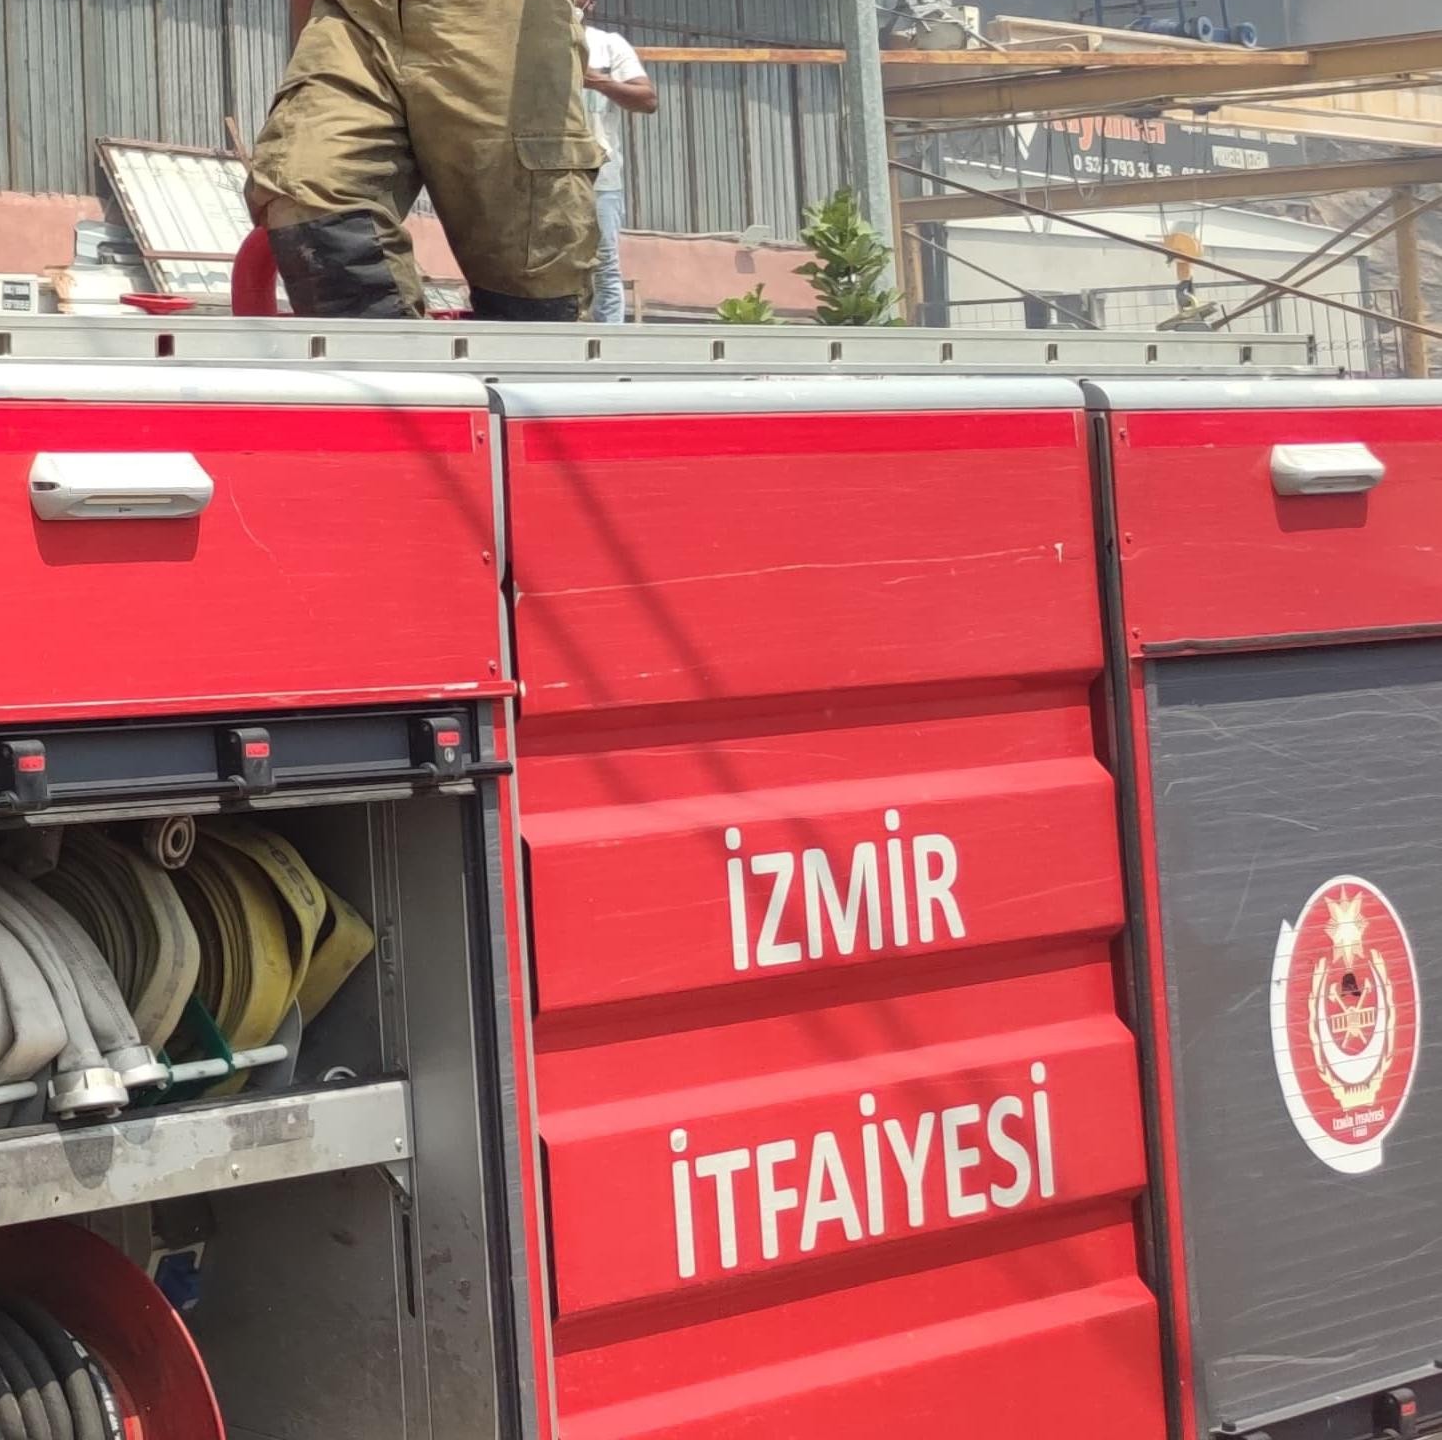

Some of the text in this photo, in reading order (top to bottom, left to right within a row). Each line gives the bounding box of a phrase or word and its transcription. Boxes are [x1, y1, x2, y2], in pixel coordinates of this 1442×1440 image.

[1111, 158, 1135, 178] 793
[725, 809, 966, 971] İZMİR
[670, 1061, 1056, 1278] İTFAİYESİ
